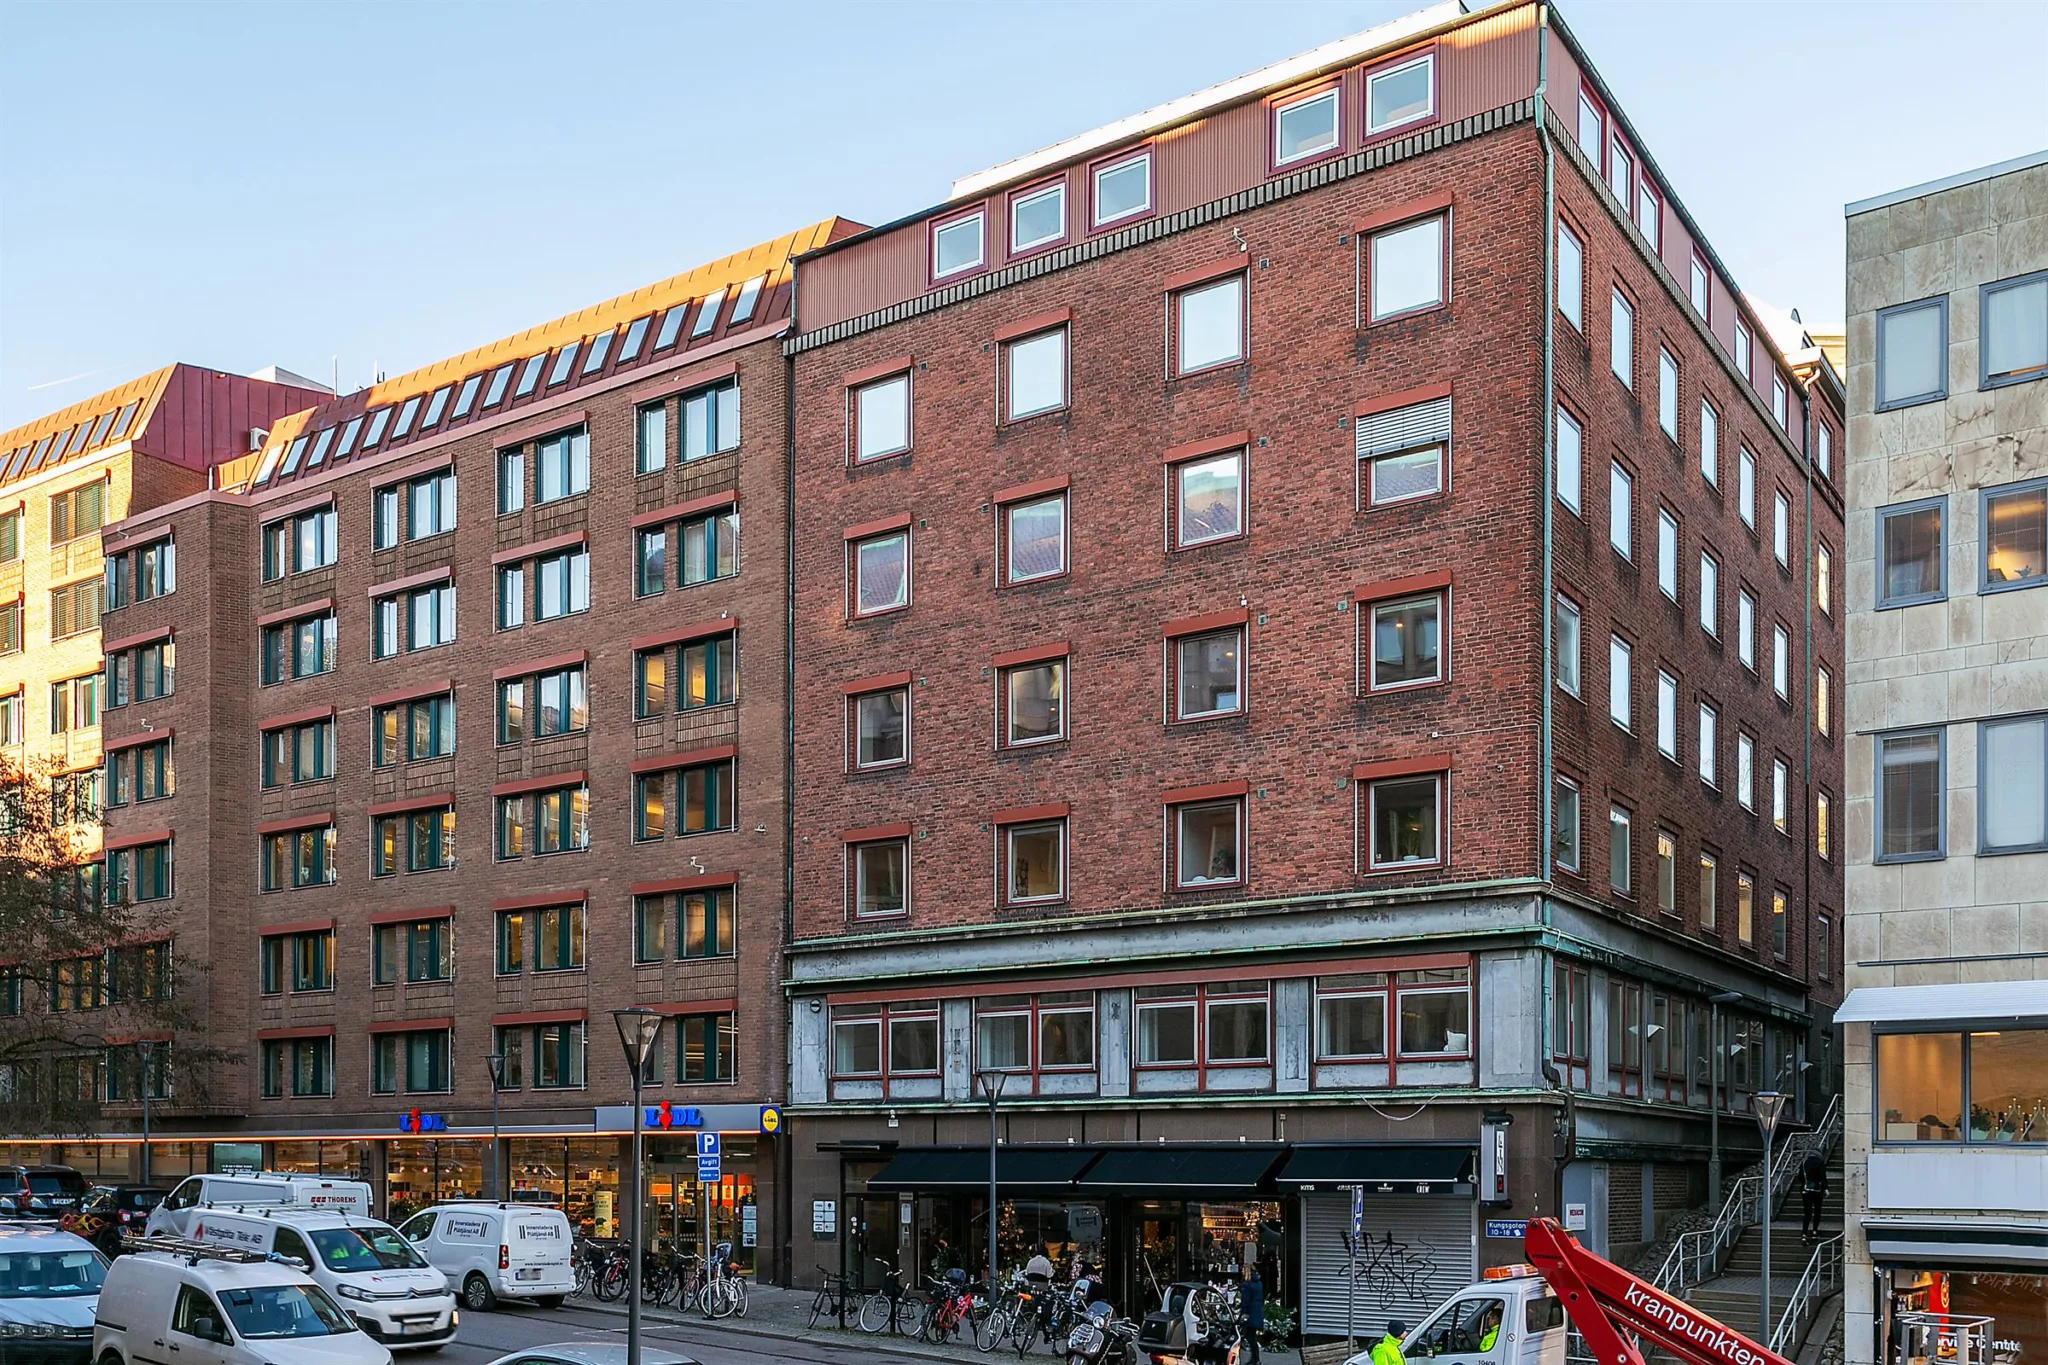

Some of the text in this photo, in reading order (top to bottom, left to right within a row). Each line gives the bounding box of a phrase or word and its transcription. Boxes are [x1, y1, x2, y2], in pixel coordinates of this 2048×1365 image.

[704, 1134, 715, 1153] P
[701, 1158, 718, 1167] Avgift
[1489, 1222, 1527, 1230] Kungsgatan
[1624, 1281, 1766, 1365] kranpunkten
